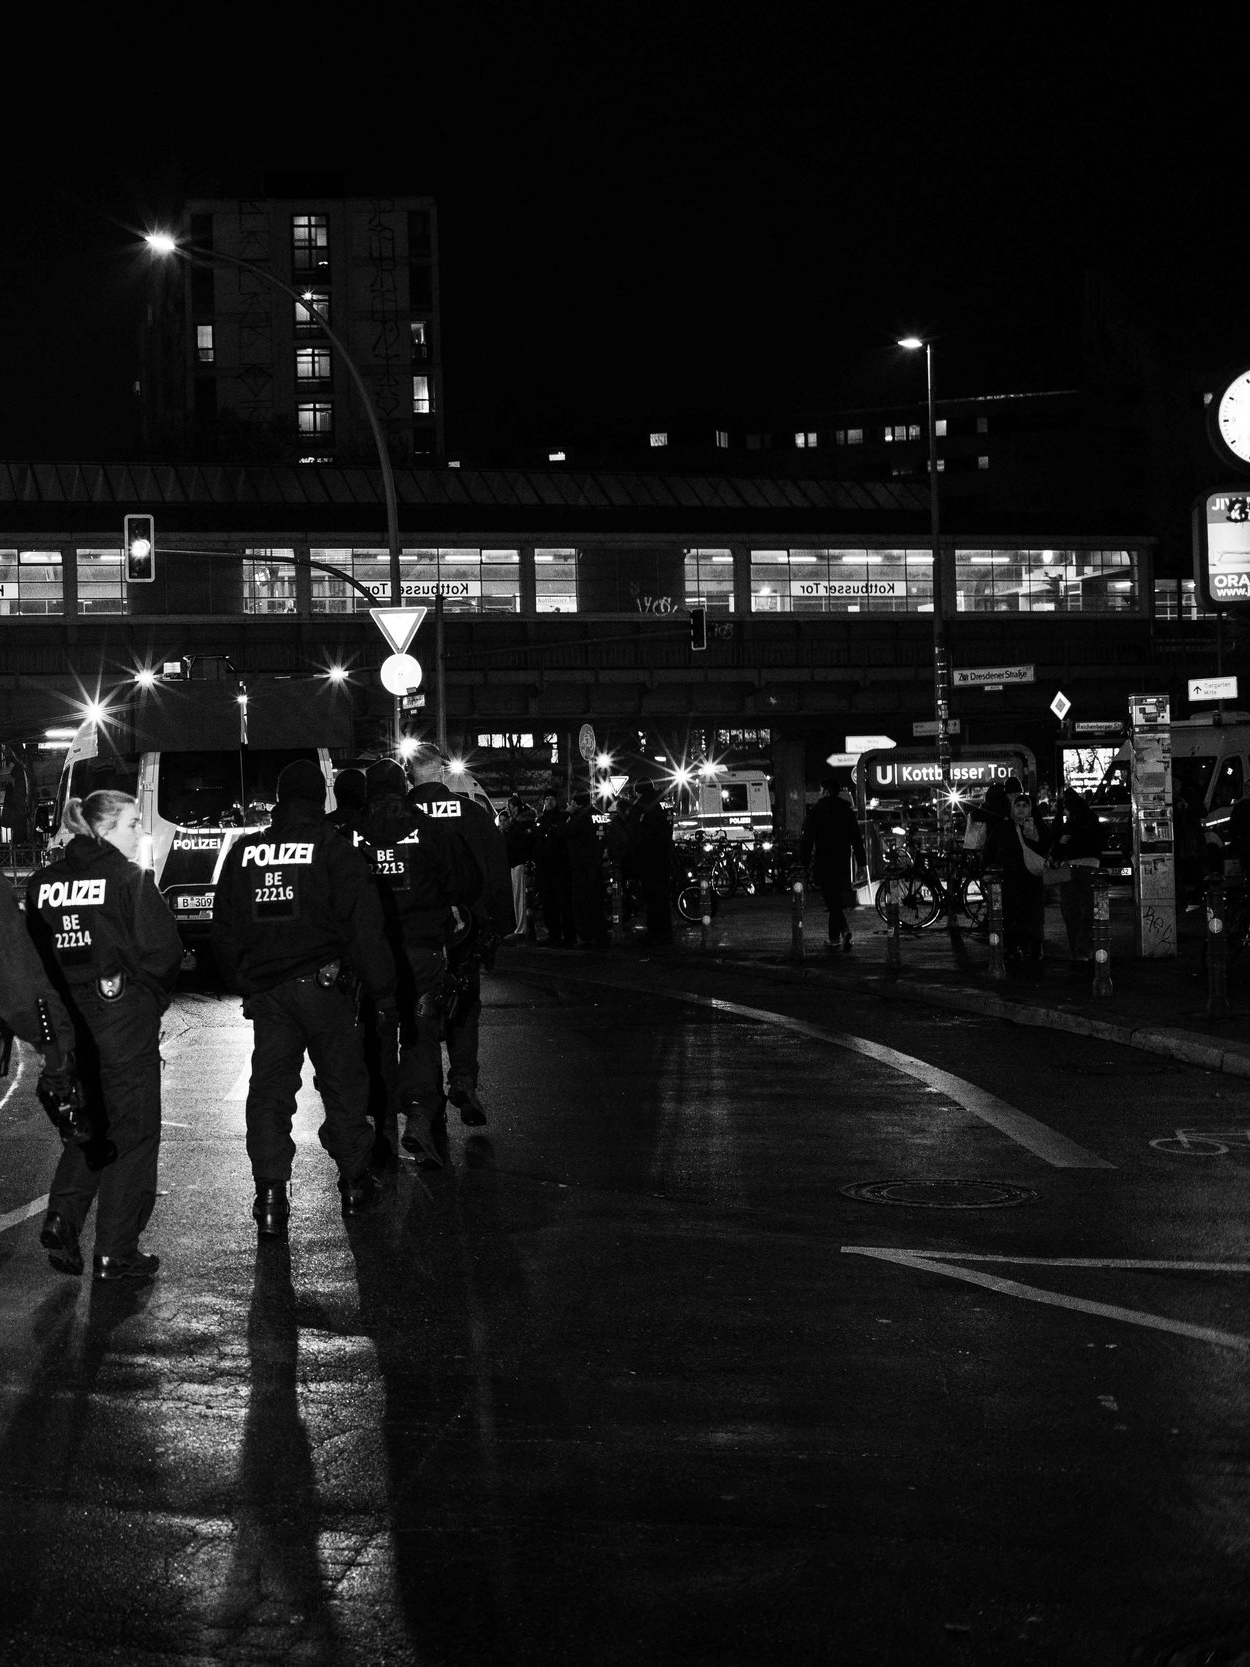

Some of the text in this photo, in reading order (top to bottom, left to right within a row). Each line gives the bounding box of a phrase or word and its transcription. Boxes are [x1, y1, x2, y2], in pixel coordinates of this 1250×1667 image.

[876, 766, 893, 785] U
[988, 763, 1014, 779] Tor
[173, 839, 221, 851] POLIZEI
[241, 843, 314, 868] POLIZEI
[377, 849, 395, 862] BE
[265, 871, 283, 887] BE
[37, 878, 107, 909] POLIZEI
[255, 886, 294, 902] 22216
[62, 914, 81, 931] BE
[55, 930, 92, 949] 22214
